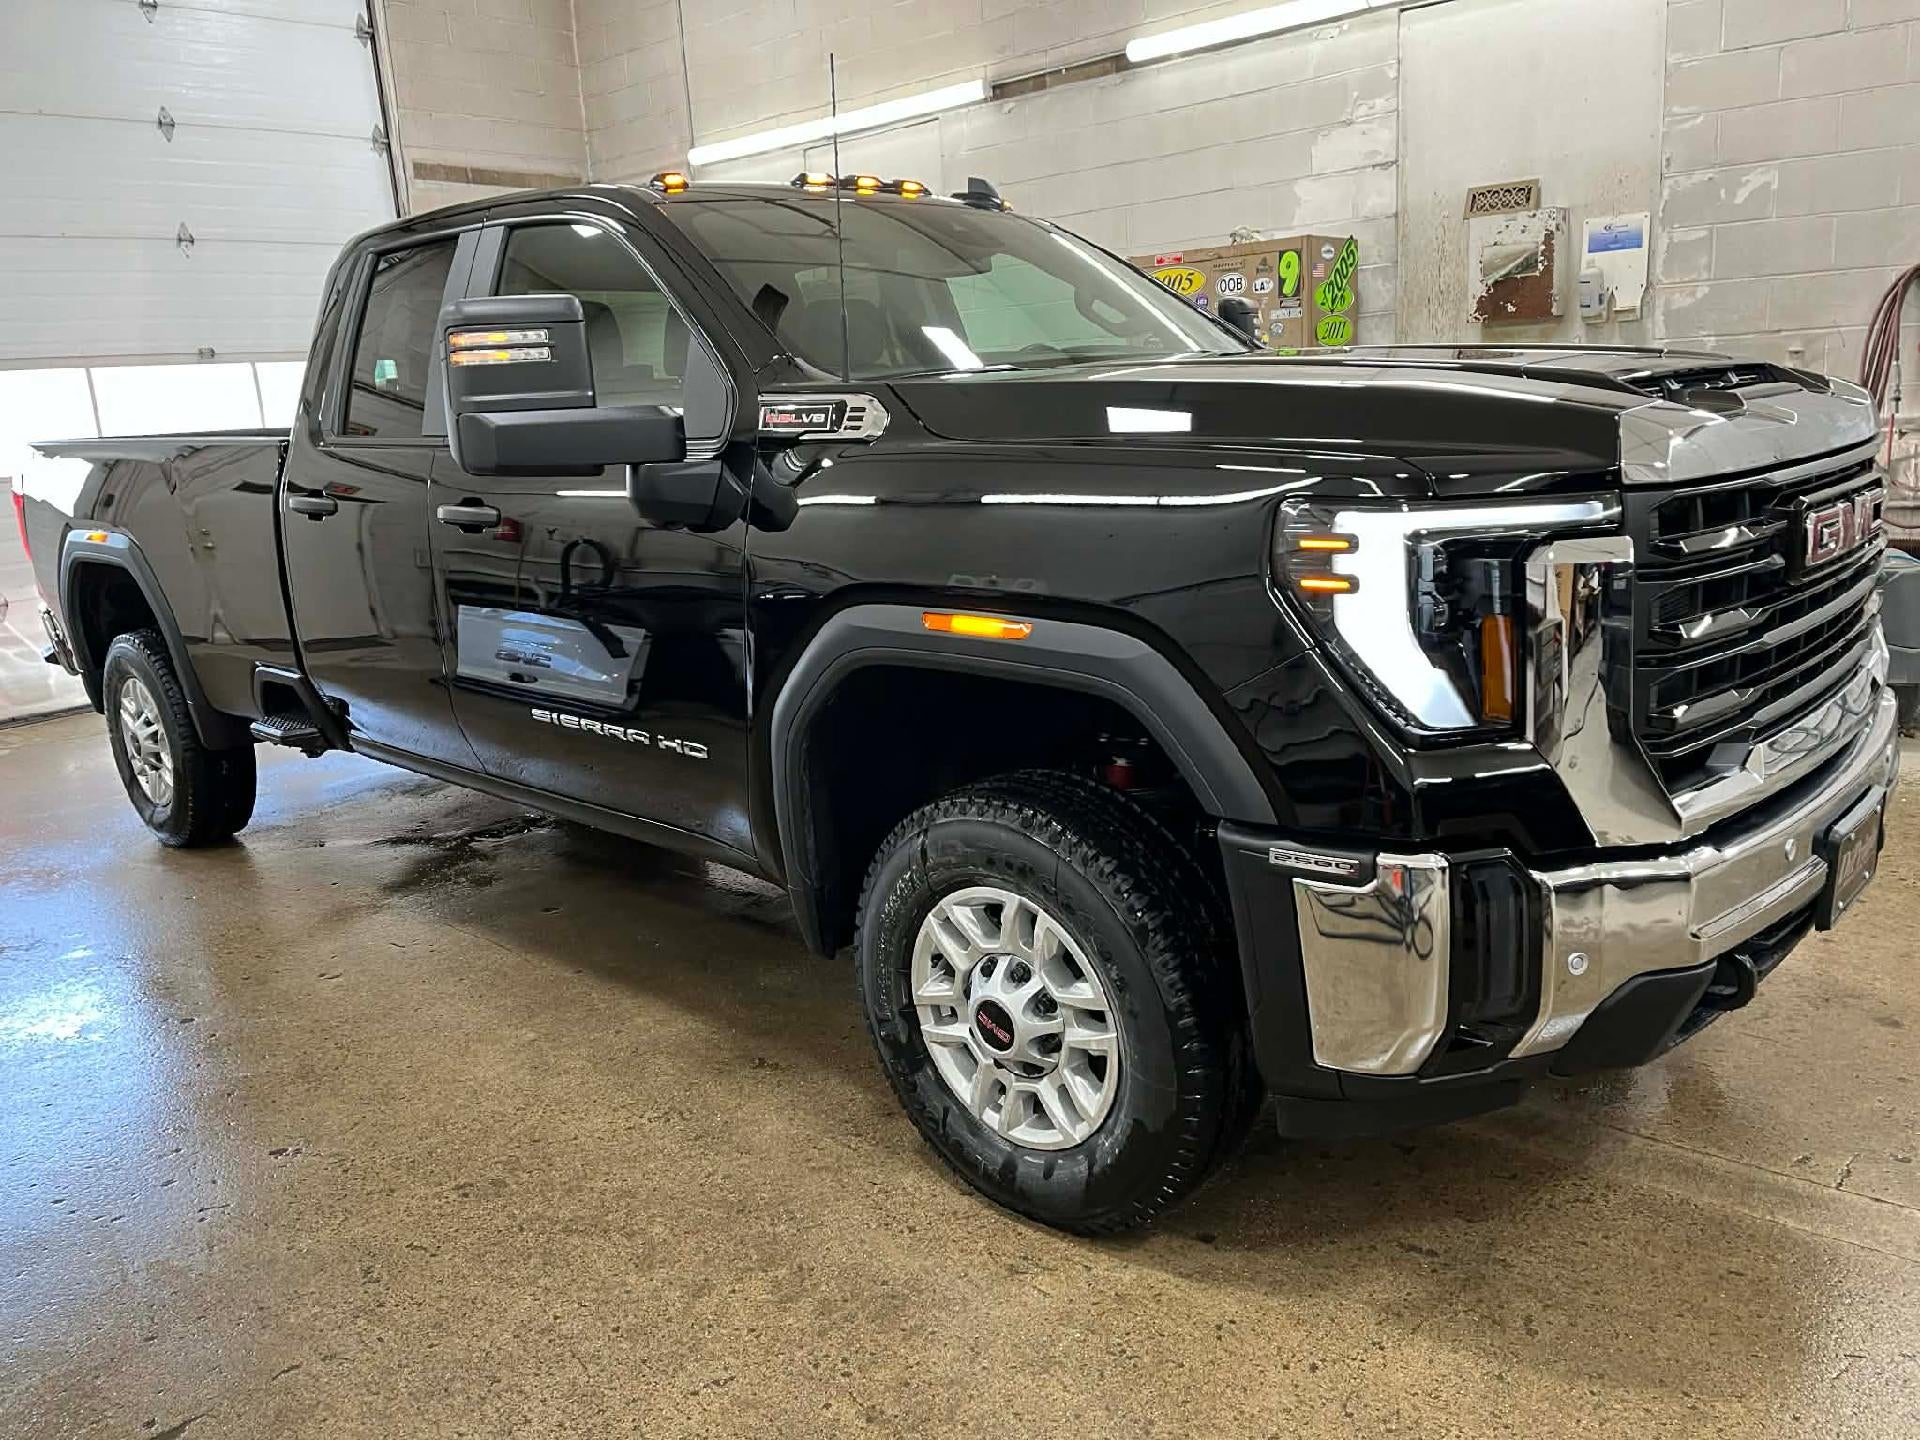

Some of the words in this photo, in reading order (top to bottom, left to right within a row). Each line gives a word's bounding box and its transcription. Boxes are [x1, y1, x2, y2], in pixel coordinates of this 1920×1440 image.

[1279, 250, 1299, 296] 9
[1806, 488, 1882, 566] GMC
[531, 708, 650, 745] SIERRA
[657, 735, 708, 759] HD
[1274, 853, 1354, 870] 2500
